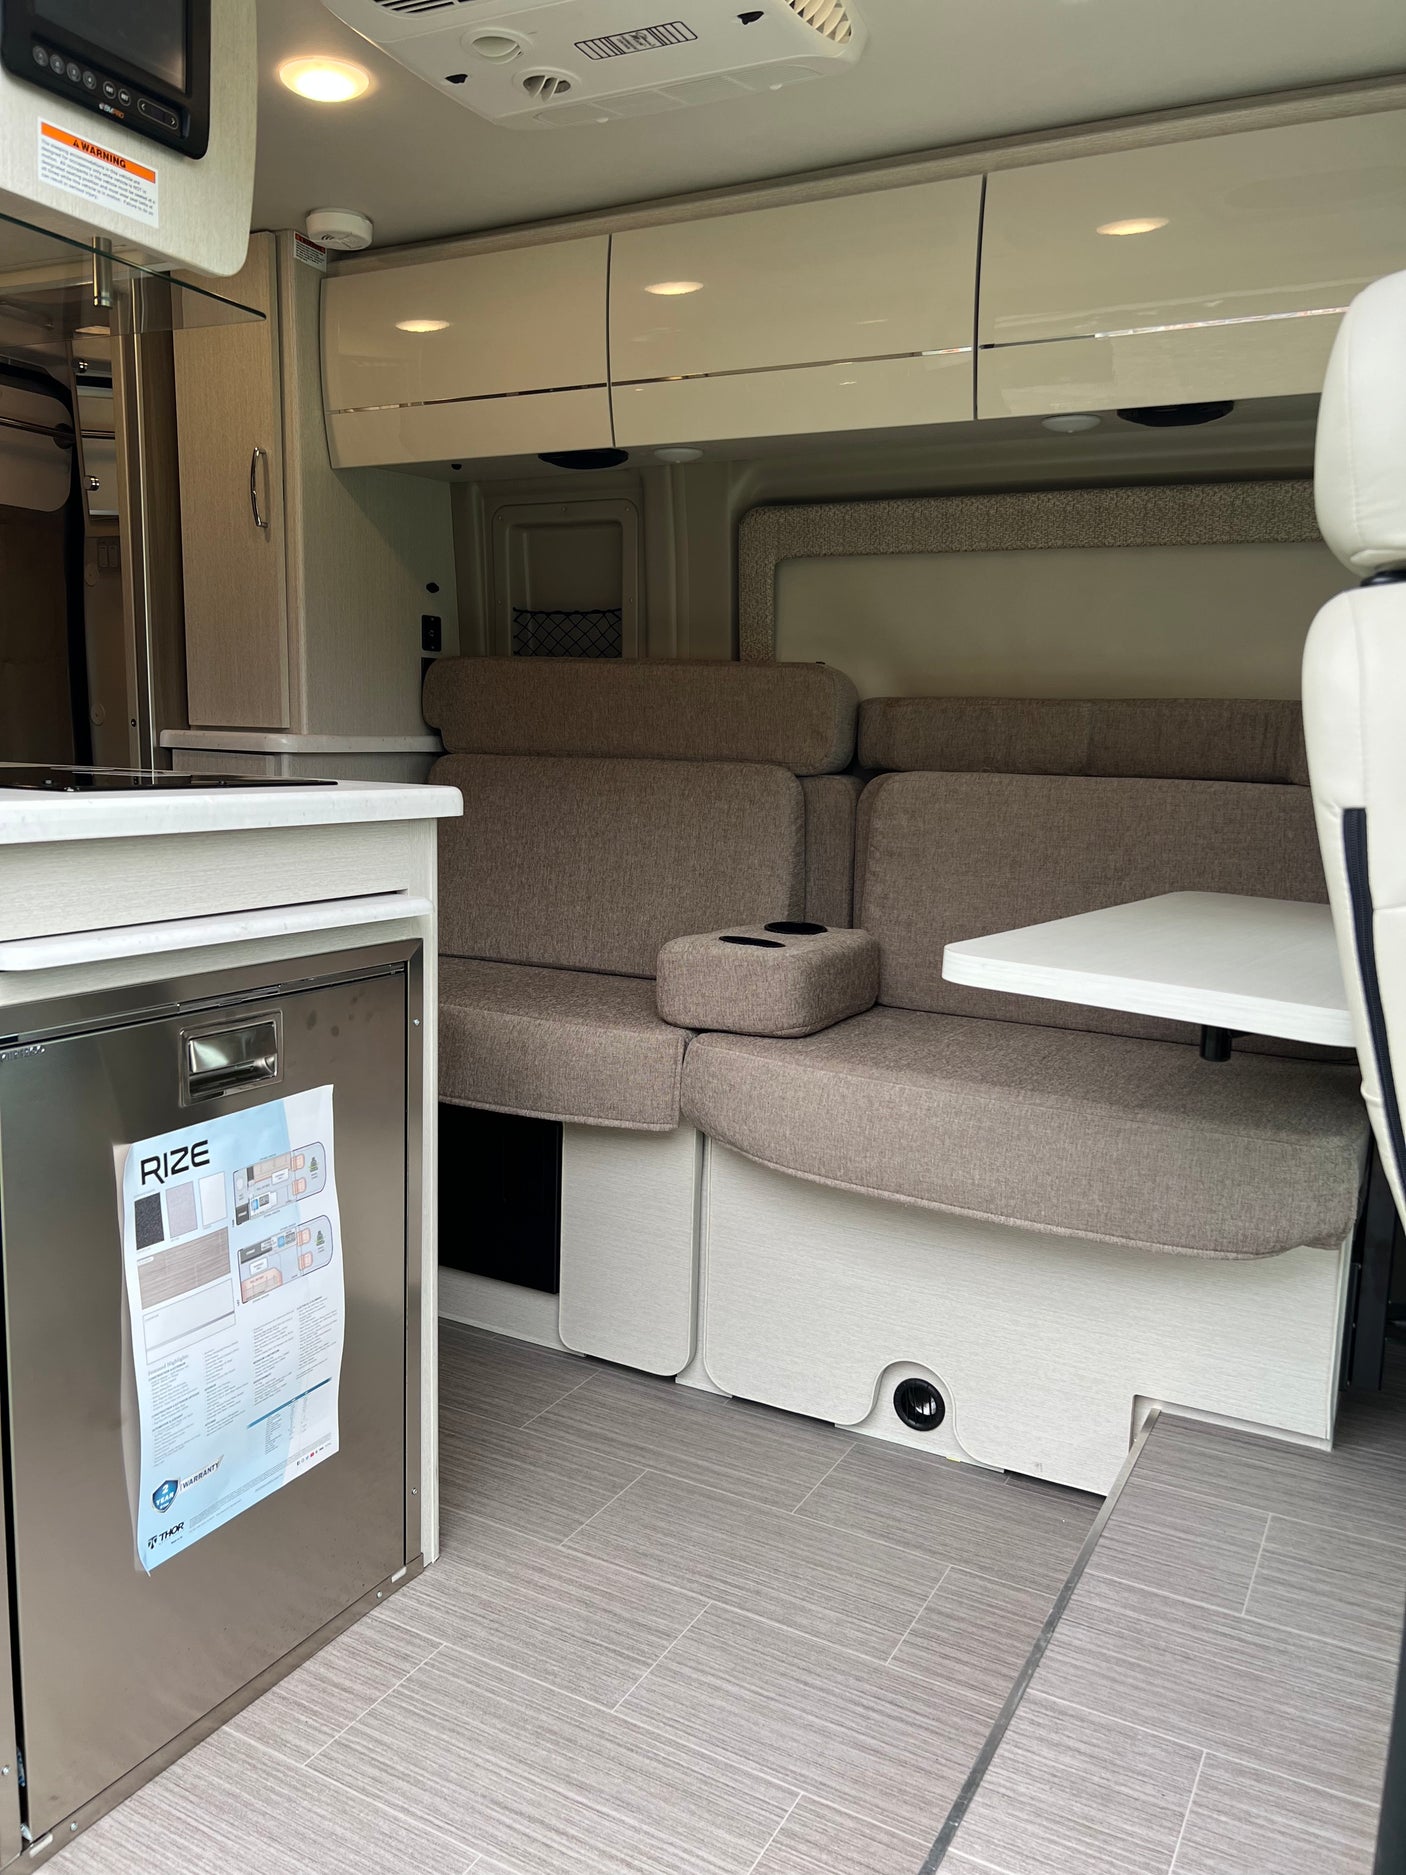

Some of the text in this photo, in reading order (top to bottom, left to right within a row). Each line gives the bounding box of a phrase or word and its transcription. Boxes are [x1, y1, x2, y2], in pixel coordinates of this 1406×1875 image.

[81, 141, 126, 169] WARNING
[140, 1140, 210, 1185] RIZE
[182, 1461, 220, 1489] WARRANTY
[162, 1484, 169, 1495] 2
[158, 1522, 184, 1541] THOR
